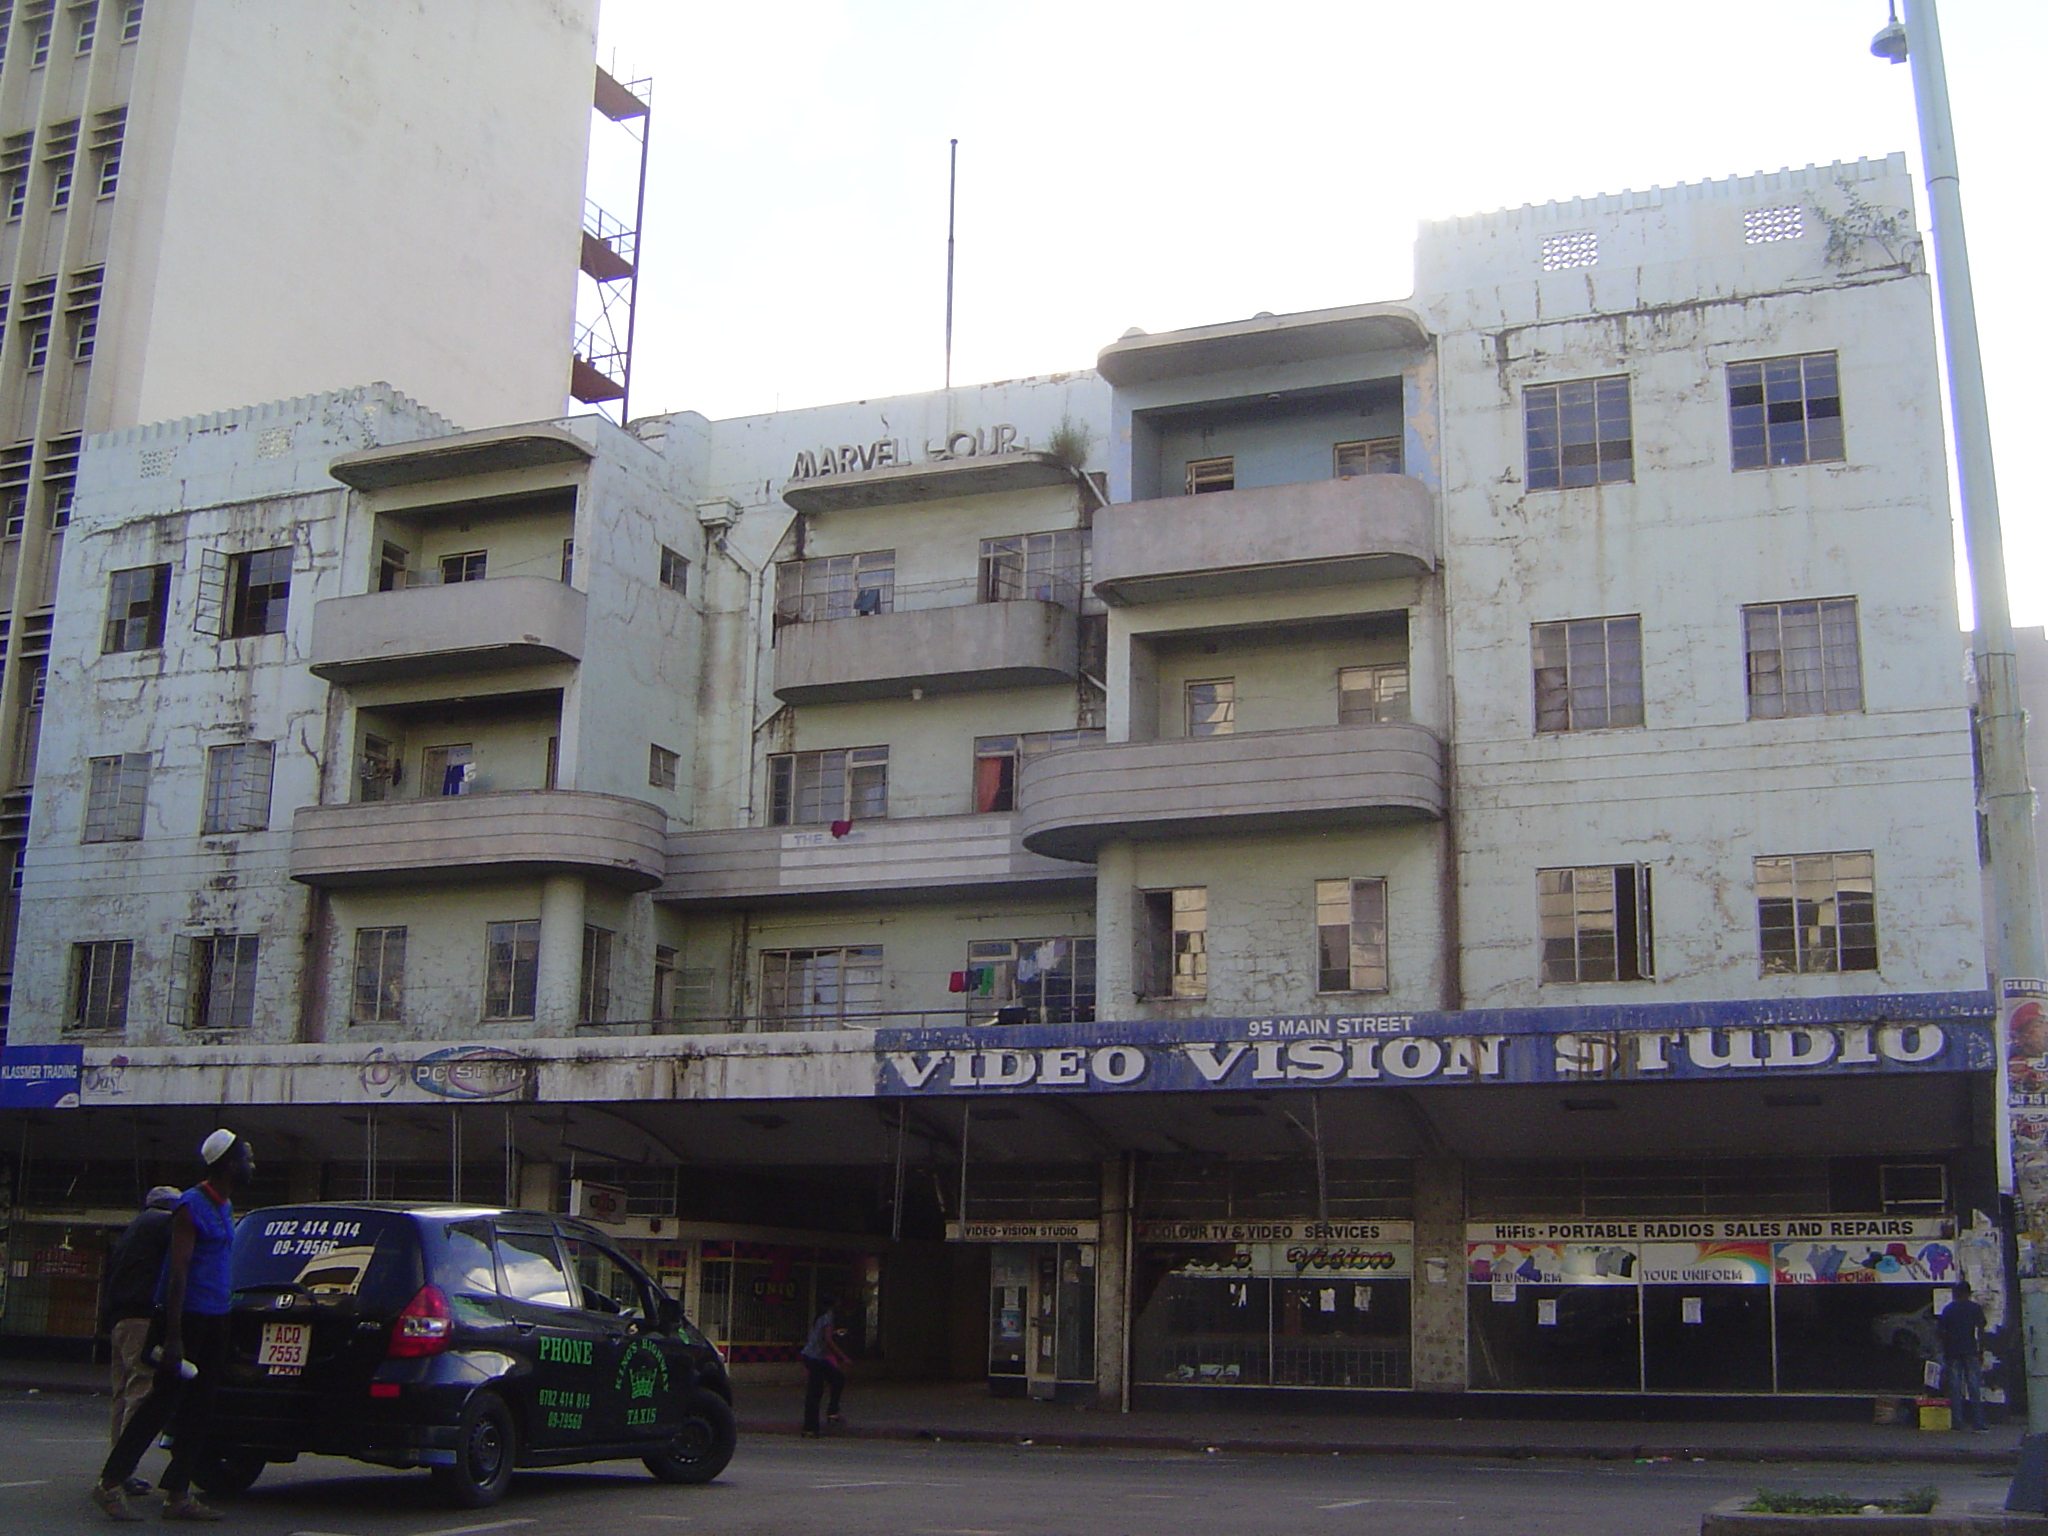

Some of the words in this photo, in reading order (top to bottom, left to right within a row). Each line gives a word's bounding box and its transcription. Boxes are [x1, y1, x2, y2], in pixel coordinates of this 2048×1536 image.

[789, 437, 911, 482] MARVEL
[2005, 980, 2040, 990] CLUB
[1248, 1022, 1273, 1037] 95
[1279, 1019, 1330, 1036] MAIN
[1337, 1016, 1414, 1034] STREET
[884, 1046, 1146, 1087] VIDEO
[1185, 1036, 1503, 1081] VISION
[43, 1065, 77, 1079] TRADING
[416, 1066, 446, 1082] PC
[264, 1221, 299, 1236] 0782
[301, 1221, 329, 1235] 414
[332, 1221, 361, 1237] 014
[965, 1226, 1037, 1236] VIDEO-VISION
[1040, 1226, 1078, 1236] STUDIO
[1212, 1226, 1228, 1238] TV
[1231, 1226, 1244, 1238] &
[1249, 1226, 1293, 1238] VIDEO
[1304, 1225, 1380, 1239] SERVICES
[1549, 1224, 1638, 1238] PORTABLE
[1644, 1223, 1715, 1237] RADIOS
[1724, 1223, 1781, 1237] SALES
[1786, 1222, 1823, 1236] AND
[1831, 1221, 1914, 1235] REPAIRS
[1287, 1246, 1395, 1272] Vision
[1643, 1269, 1678, 1281] YOUR
[1682, 1268, 1743, 1281] UNIFORM
[268, 1345, 302, 1363] 7553
[539, 1336, 593, 1365] PHONE
[559, 1391, 574, 1407] 414
[626, 1408, 657, 1425] TAXIS
